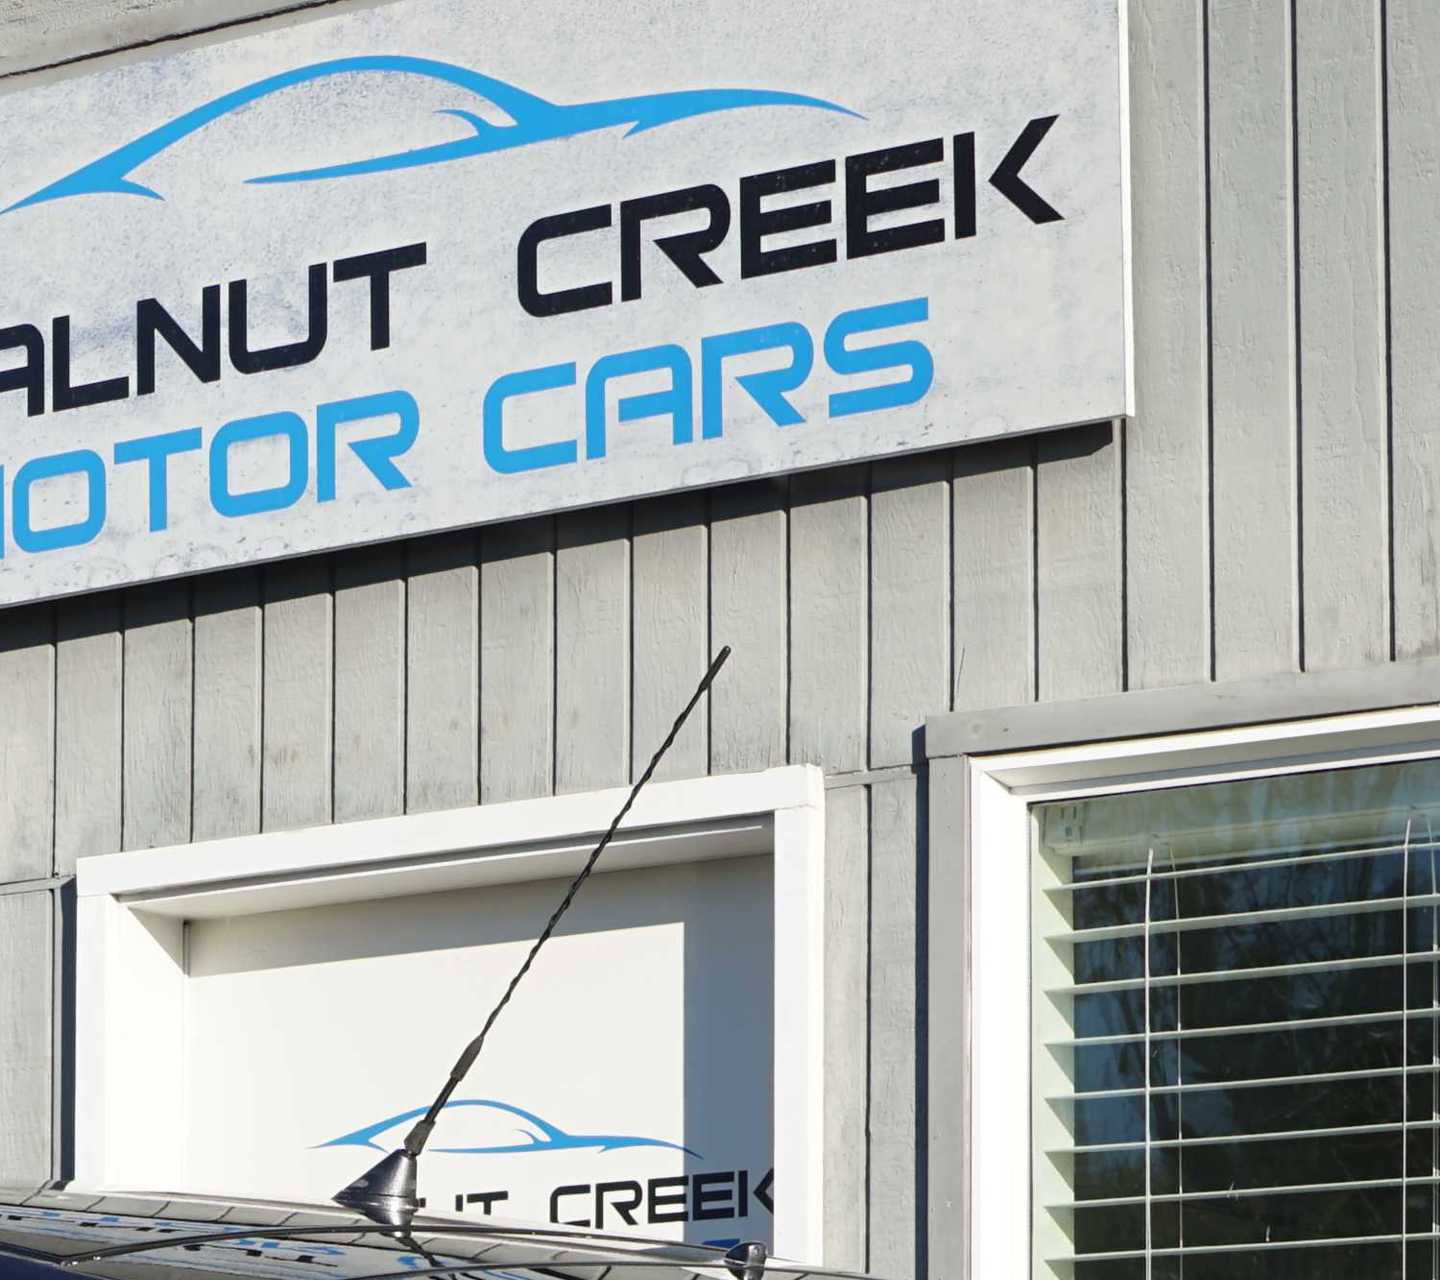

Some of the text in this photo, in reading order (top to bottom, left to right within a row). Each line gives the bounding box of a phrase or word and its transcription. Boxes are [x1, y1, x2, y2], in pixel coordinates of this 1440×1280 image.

[518, 115, 1064, 317] CREEK
[484, 298, 933, 473] CARS
[551, 1167, 773, 1229] CREEK
